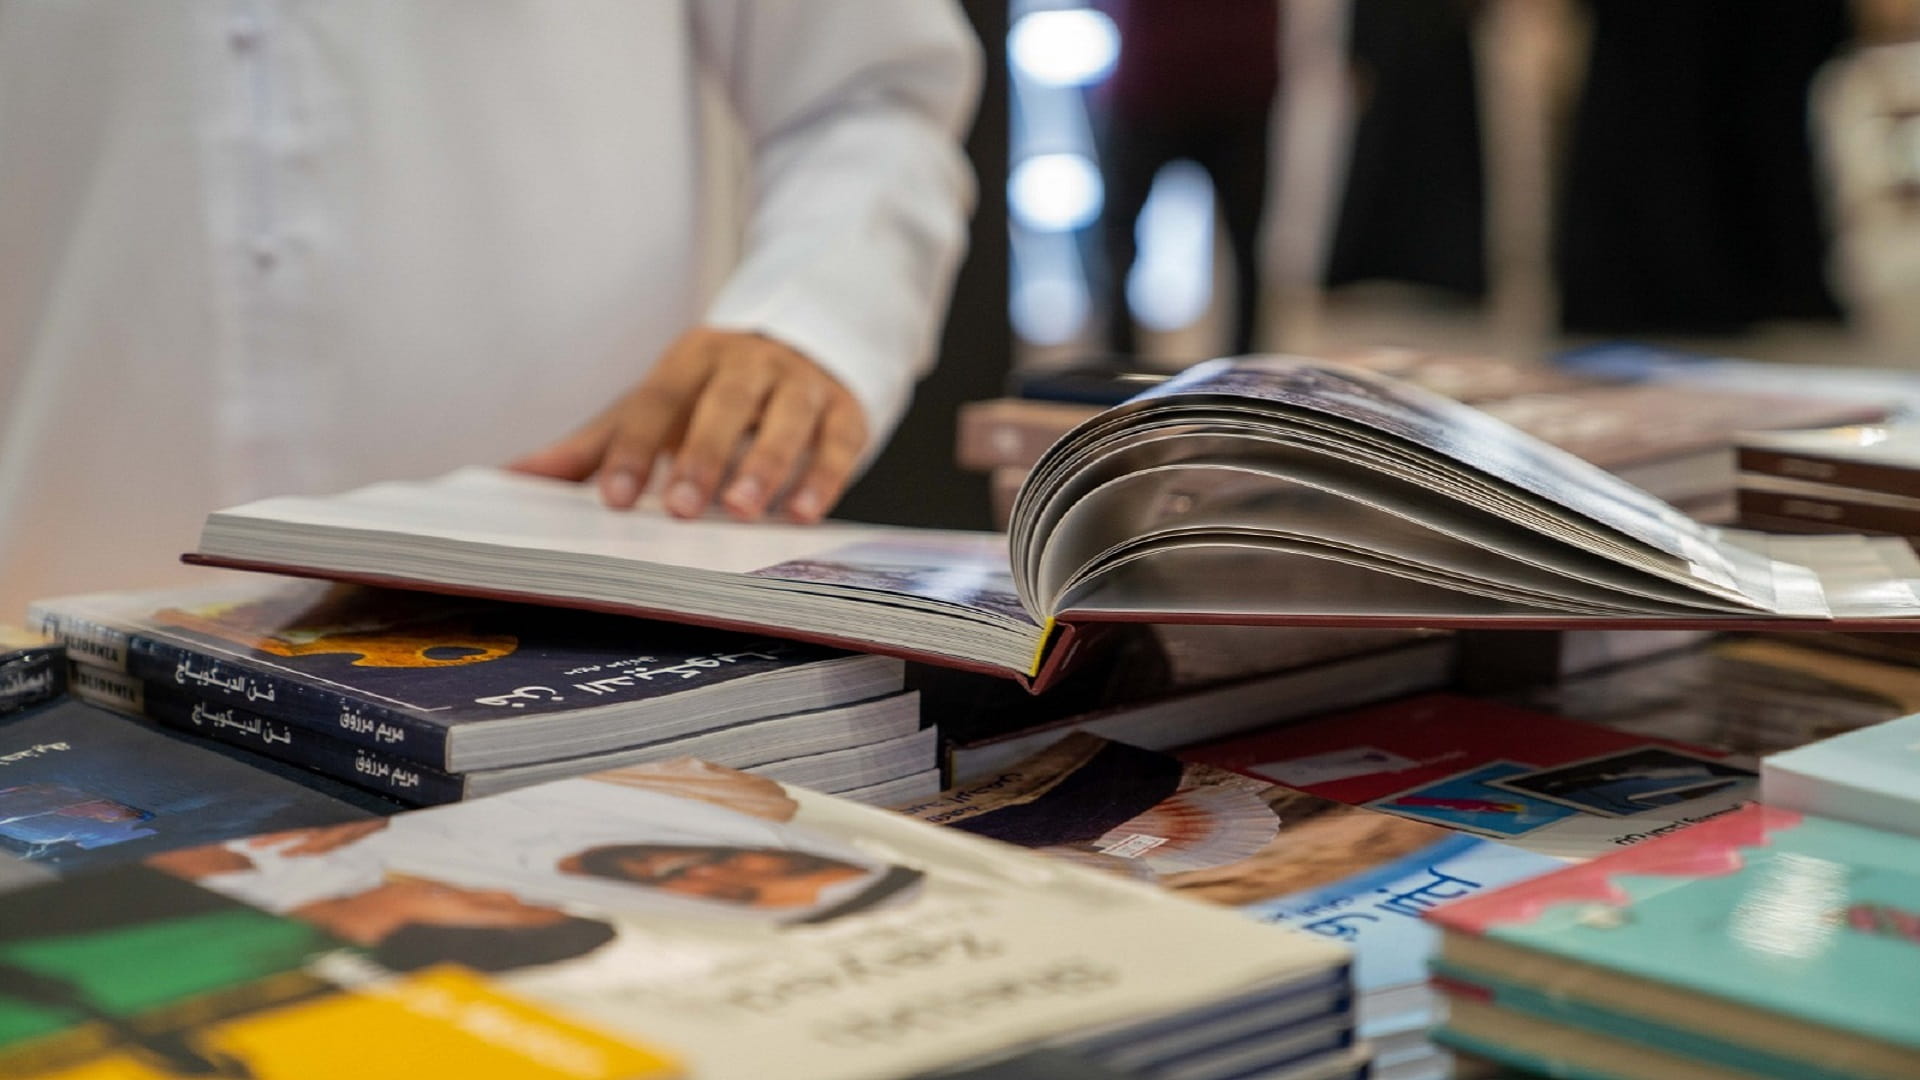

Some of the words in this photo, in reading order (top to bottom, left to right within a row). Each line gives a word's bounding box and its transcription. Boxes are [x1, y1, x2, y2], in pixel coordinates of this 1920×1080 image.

[174, 660, 246, 694] الديكوباج
[247, 679, 276, 702] فن
[474, 685, 565, 709] فن
[191, 701, 262, 735] الديكوباج
[339, 705, 374, 733] مرزوق
[263, 721, 292, 745] فن
[375, 722, 405, 744] مريم
[355, 749, 389, 777] مرزوق
[391, 767, 420, 787] مريم
